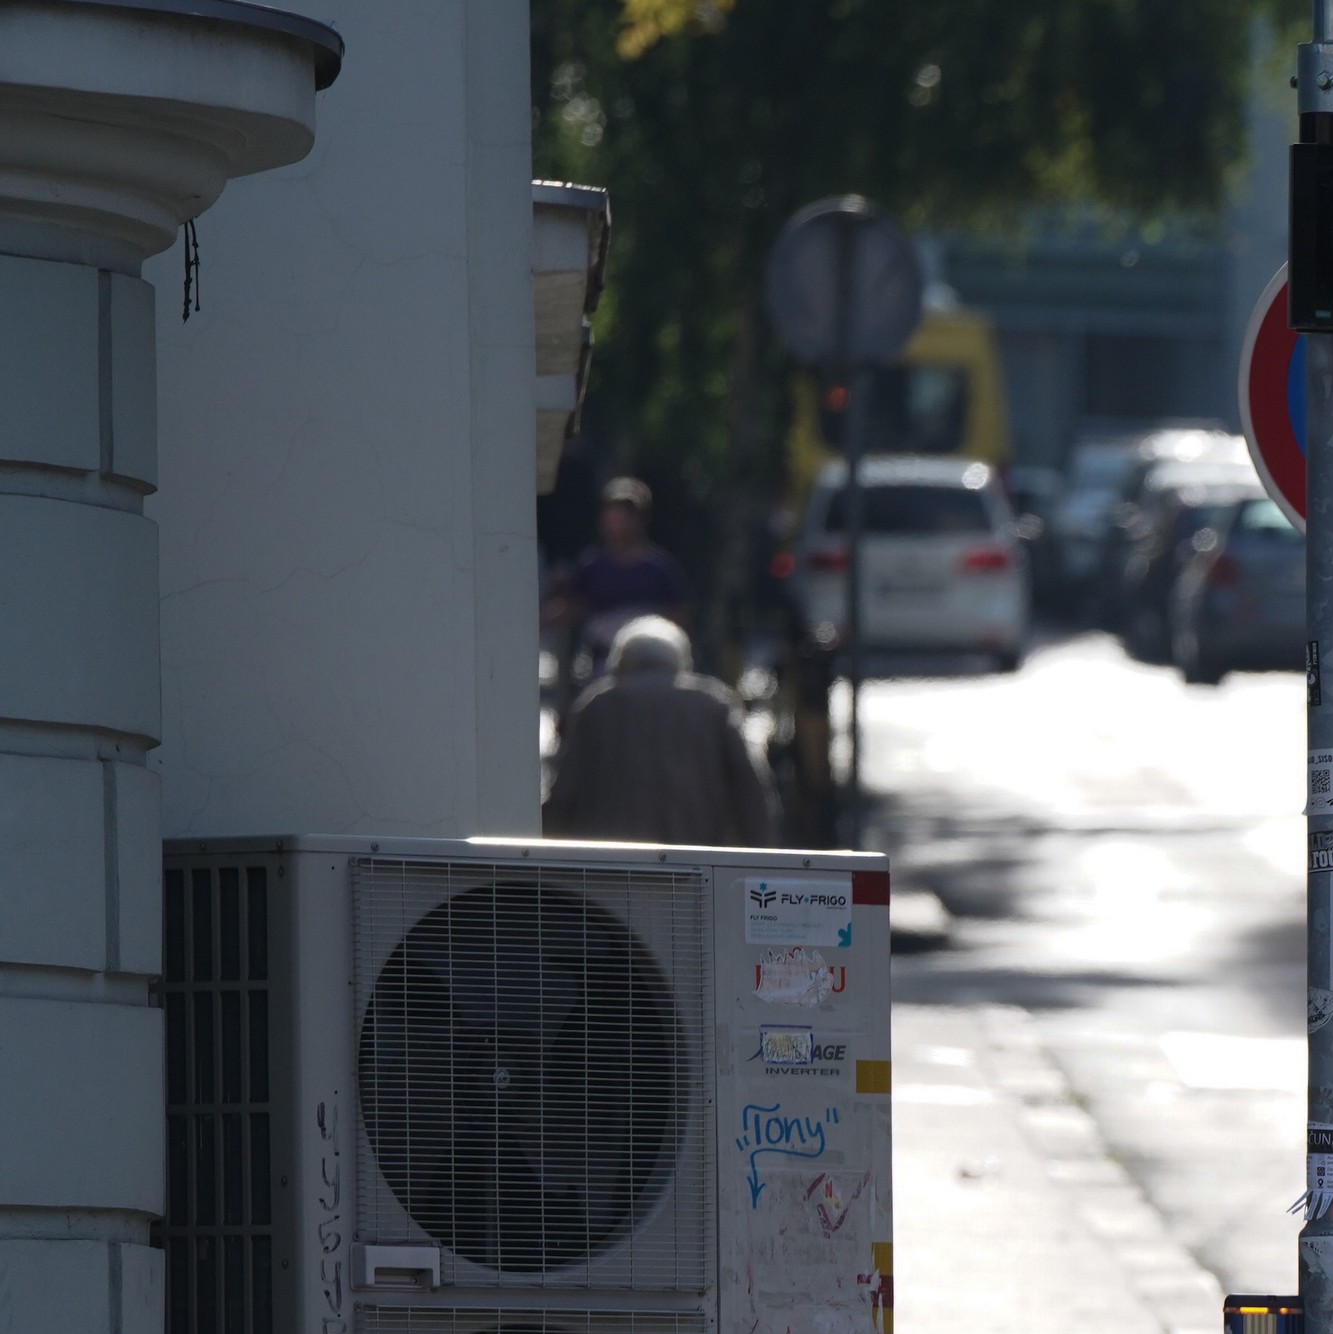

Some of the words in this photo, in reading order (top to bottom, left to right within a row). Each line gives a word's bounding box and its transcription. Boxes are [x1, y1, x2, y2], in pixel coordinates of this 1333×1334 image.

[781, 894, 804, 905] FLY
[810, 895, 847, 906] FRIGO
[765, 1067, 840, 1076] INVERTER
